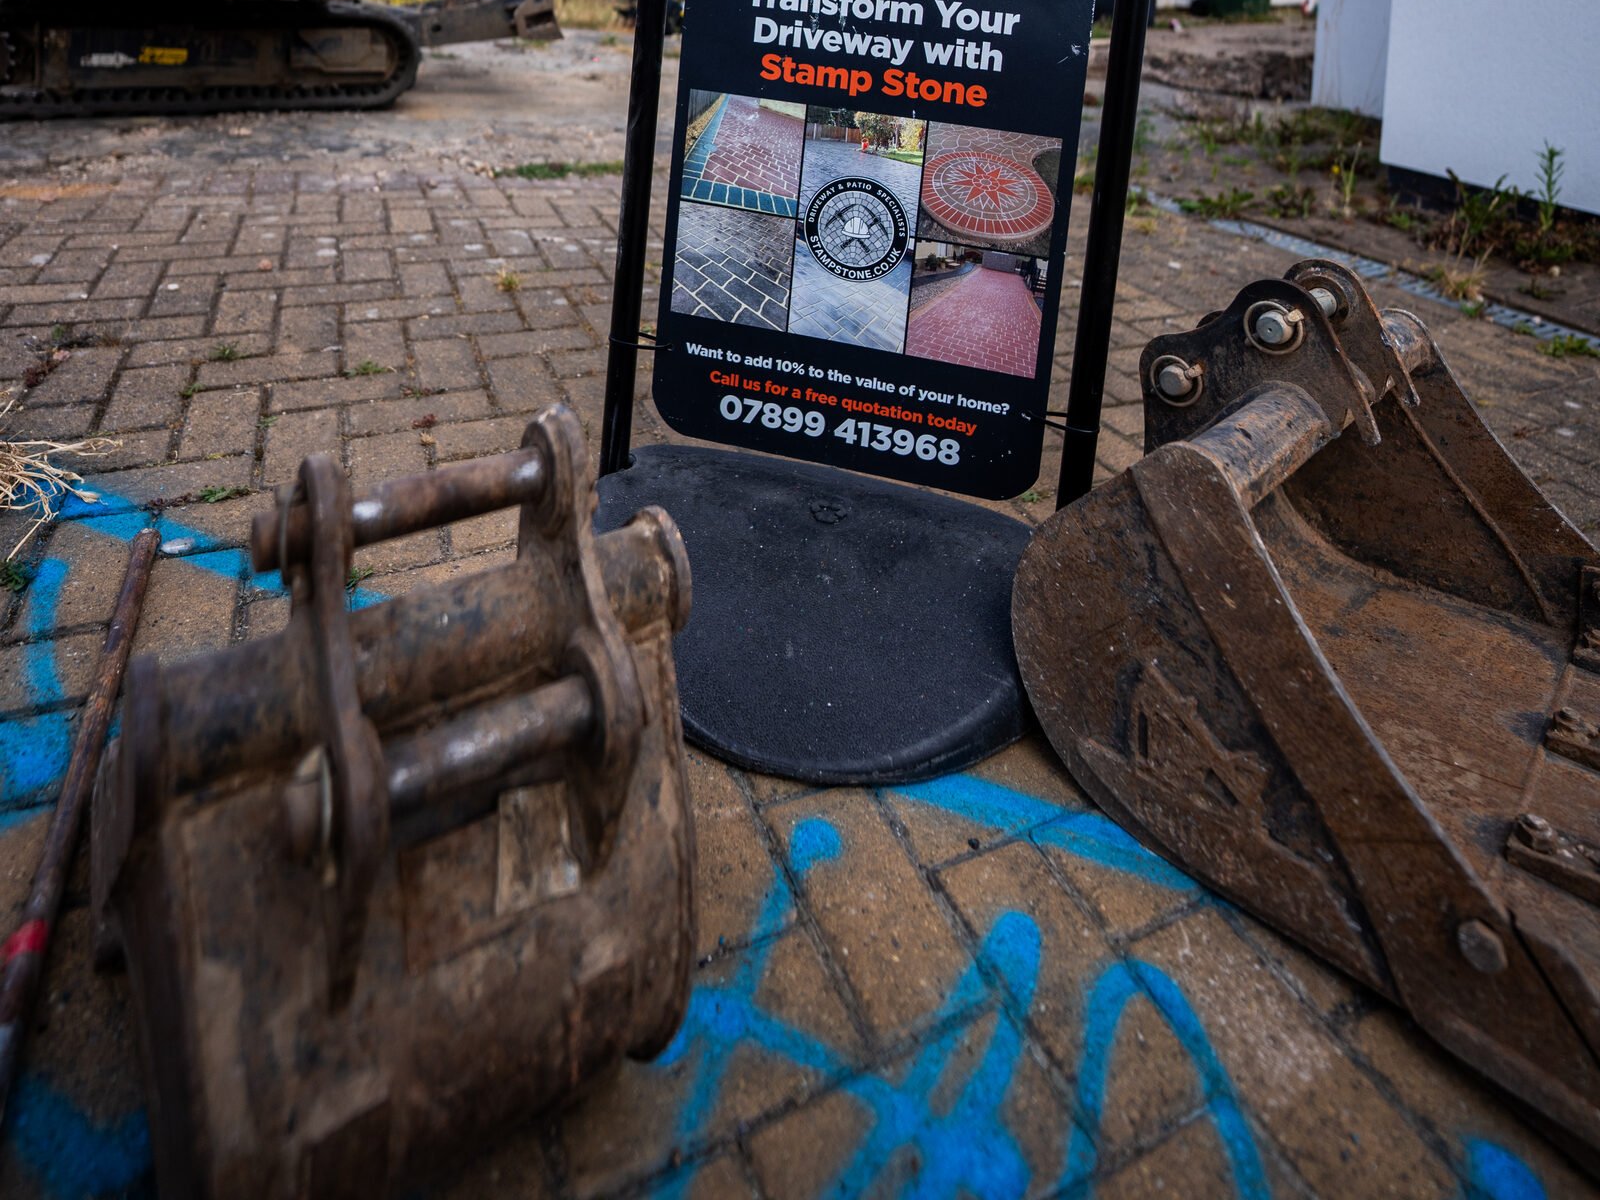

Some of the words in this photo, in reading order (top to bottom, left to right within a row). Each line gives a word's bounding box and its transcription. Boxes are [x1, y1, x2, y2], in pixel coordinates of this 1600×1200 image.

[753, 16, 914, 66] Driveway
[923, 38, 1003, 72] with
[934, 0, 1020, 36] Your
[759, 53, 872, 96] Stamp
[881, 68, 988, 108] Stone
[808, 186, 836, 223] DRIVEWAY
[846, 181, 872, 191] PATIO
[876, 189, 906, 237] SPECIALISTS
[810, 235, 901, 279] STAMPSTONE.CO.UK
[686, 342, 723, 360] Want
[726, 350, 741, 364] to
[744, 355, 772, 369] add
[775, 359, 805, 375] 10%
[808, 365, 824, 379] to
[827, 368, 852, 384] the
[855, 377, 895, 393] value
[899, 384, 916, 397] of
[918, 388, 954, 404] your
[957, 394, 1010, 415] home?
[709, 370, 739, 388] Call
[743, 378, 761, 392] us
[765, 380, 788, 396] for
[791, 388, 802, 399] a
[805, 388, 838, 406] free
[841, 398, 923, 423] quotation
[927, 413, 977, 436] today
[719, 394, 826, 438] 07899
[833, 418, 961, 466] 413968
